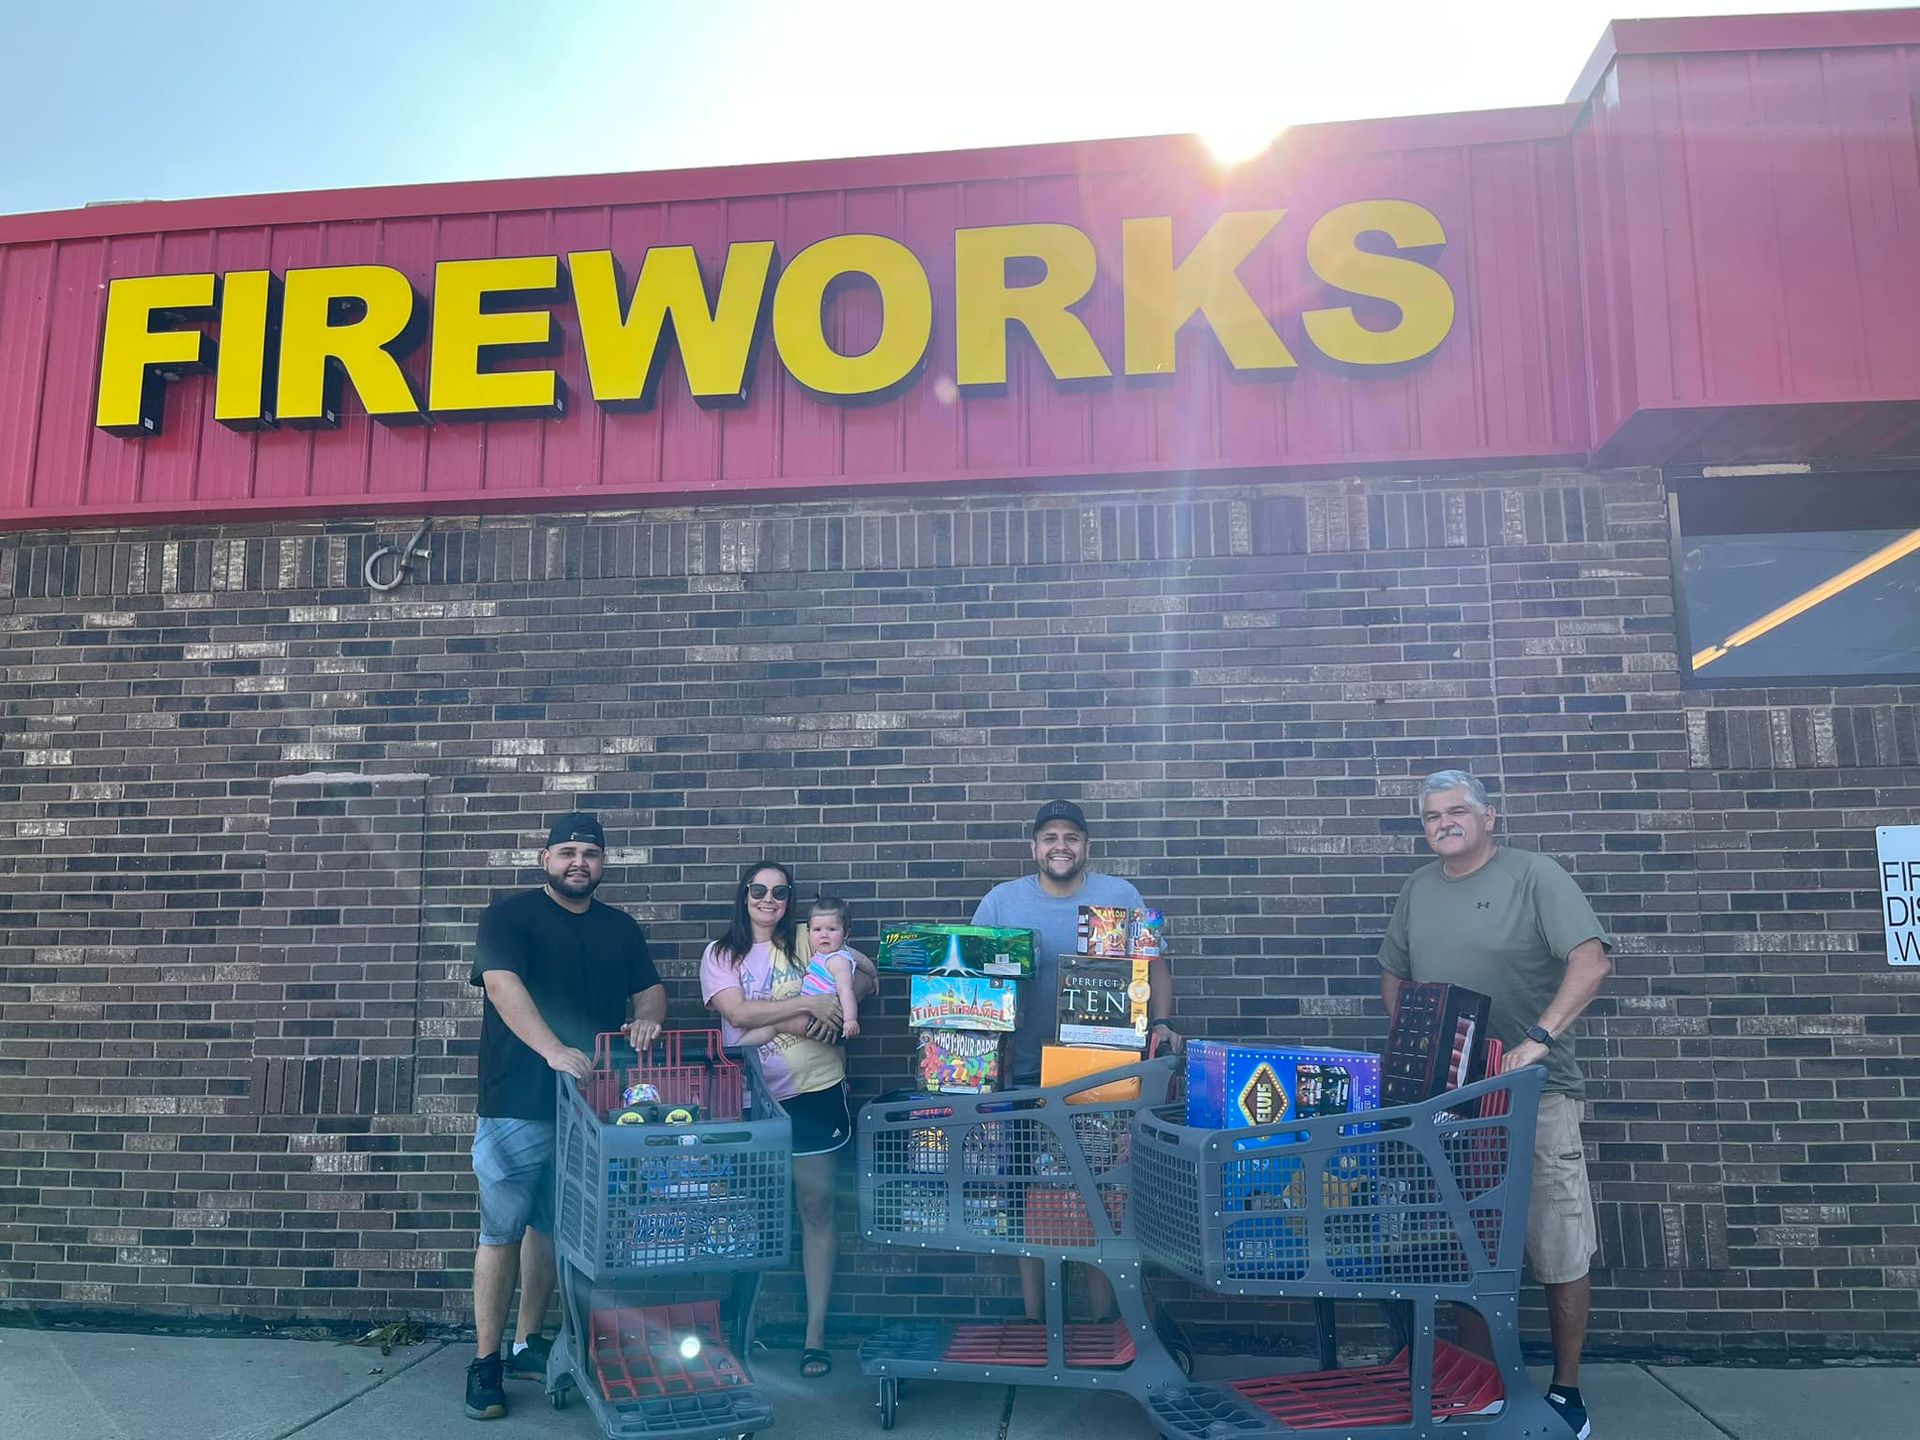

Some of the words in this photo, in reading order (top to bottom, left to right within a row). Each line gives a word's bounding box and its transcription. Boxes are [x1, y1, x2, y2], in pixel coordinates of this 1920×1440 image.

[96, 199, 1456, 429] FIREWORKS
[1887, 896, 1920, 926] DI
[1072, 976, 1118, 988] PERFECT
[913, 1005, 949, 1020] TIME
[953, 1004, 1008, 1022] TRAVEL
[1063, 988, 1126, 1014] TEN
[956, 1033, 975, 1057] YOUR
[977, 1039, 999, 1056] DADDY
[1256, 1083, 1273, 1122] ELVIS
